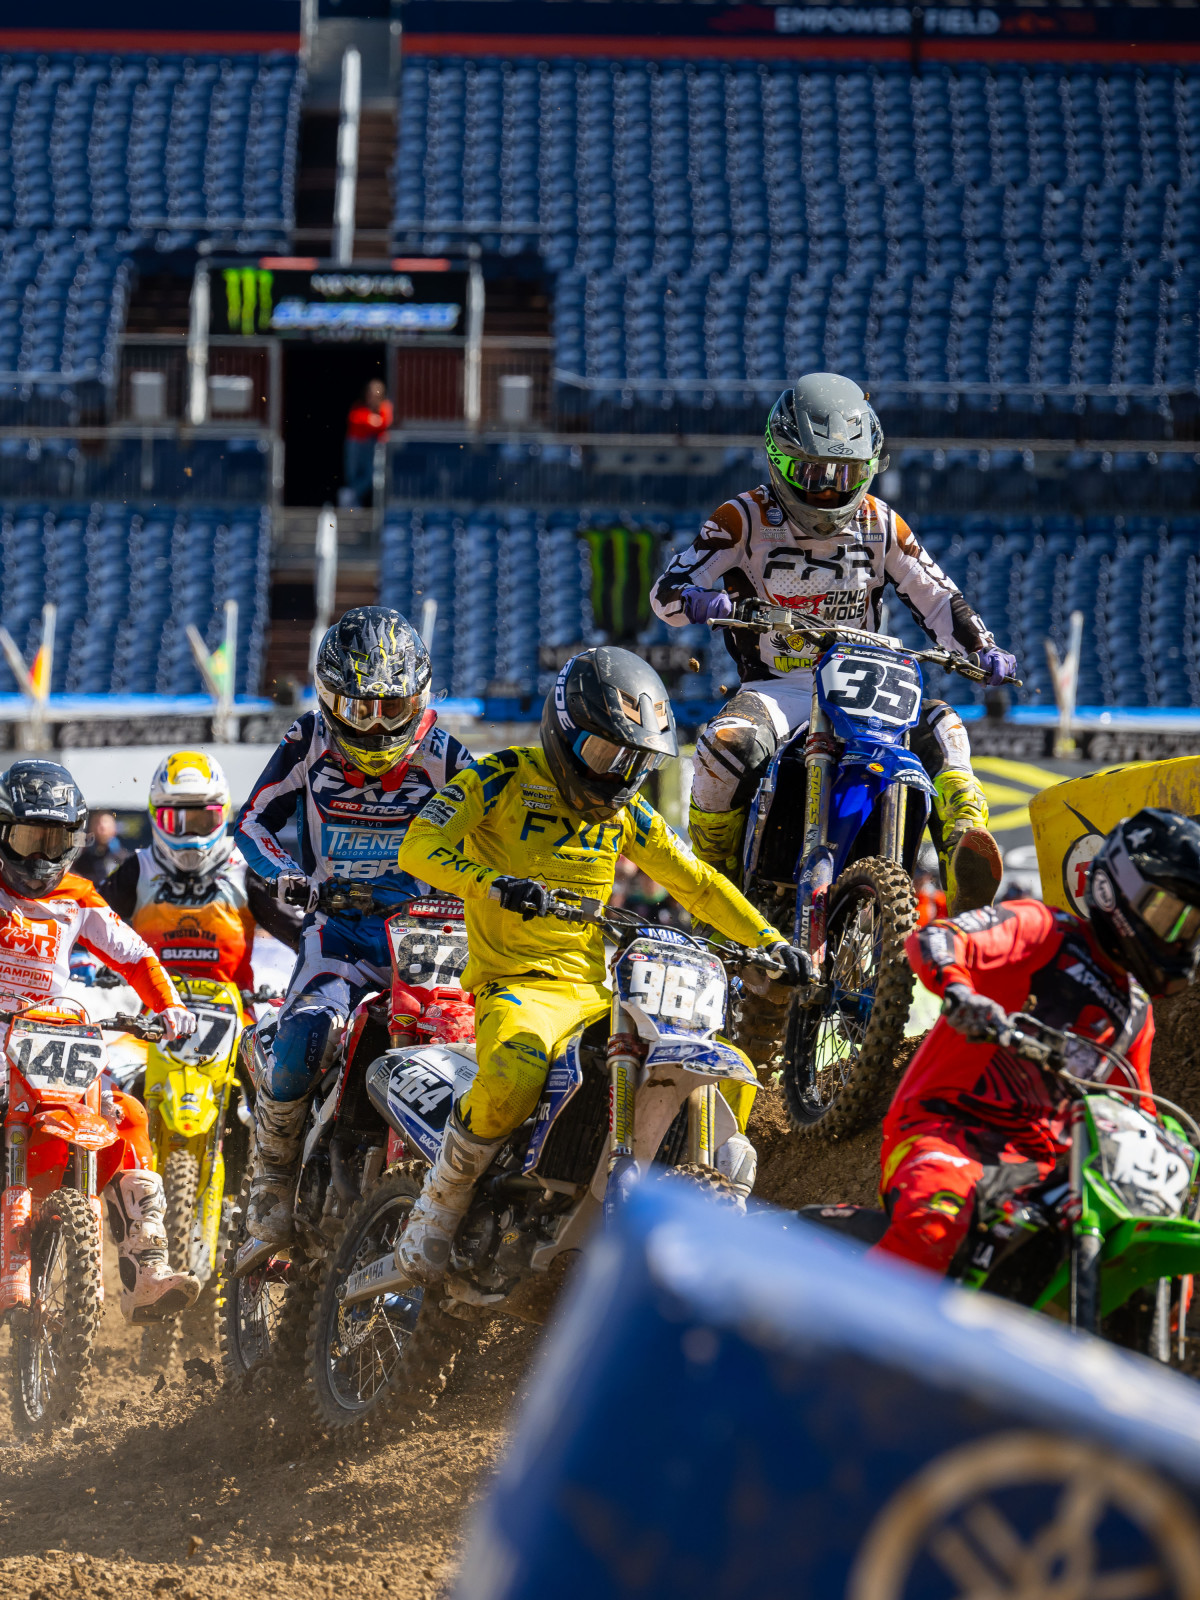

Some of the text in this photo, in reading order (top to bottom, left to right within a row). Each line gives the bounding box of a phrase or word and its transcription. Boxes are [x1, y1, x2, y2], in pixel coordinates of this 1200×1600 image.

[774, 9, 1000, 34] EMPOWER FIELD
[824, 589, 866, 606] GIZMO
[823, 603, 865, 621] MODS
[825, 659, 919, 721] 35
[412, 903, 465, 915] RENTHA
[161, 949, 219, 961] SUZUKI
[628, 960, 725, 1029] 964
[15, 1037, 102, 1089] 146
[389, 1064, 455, 1116] 964
